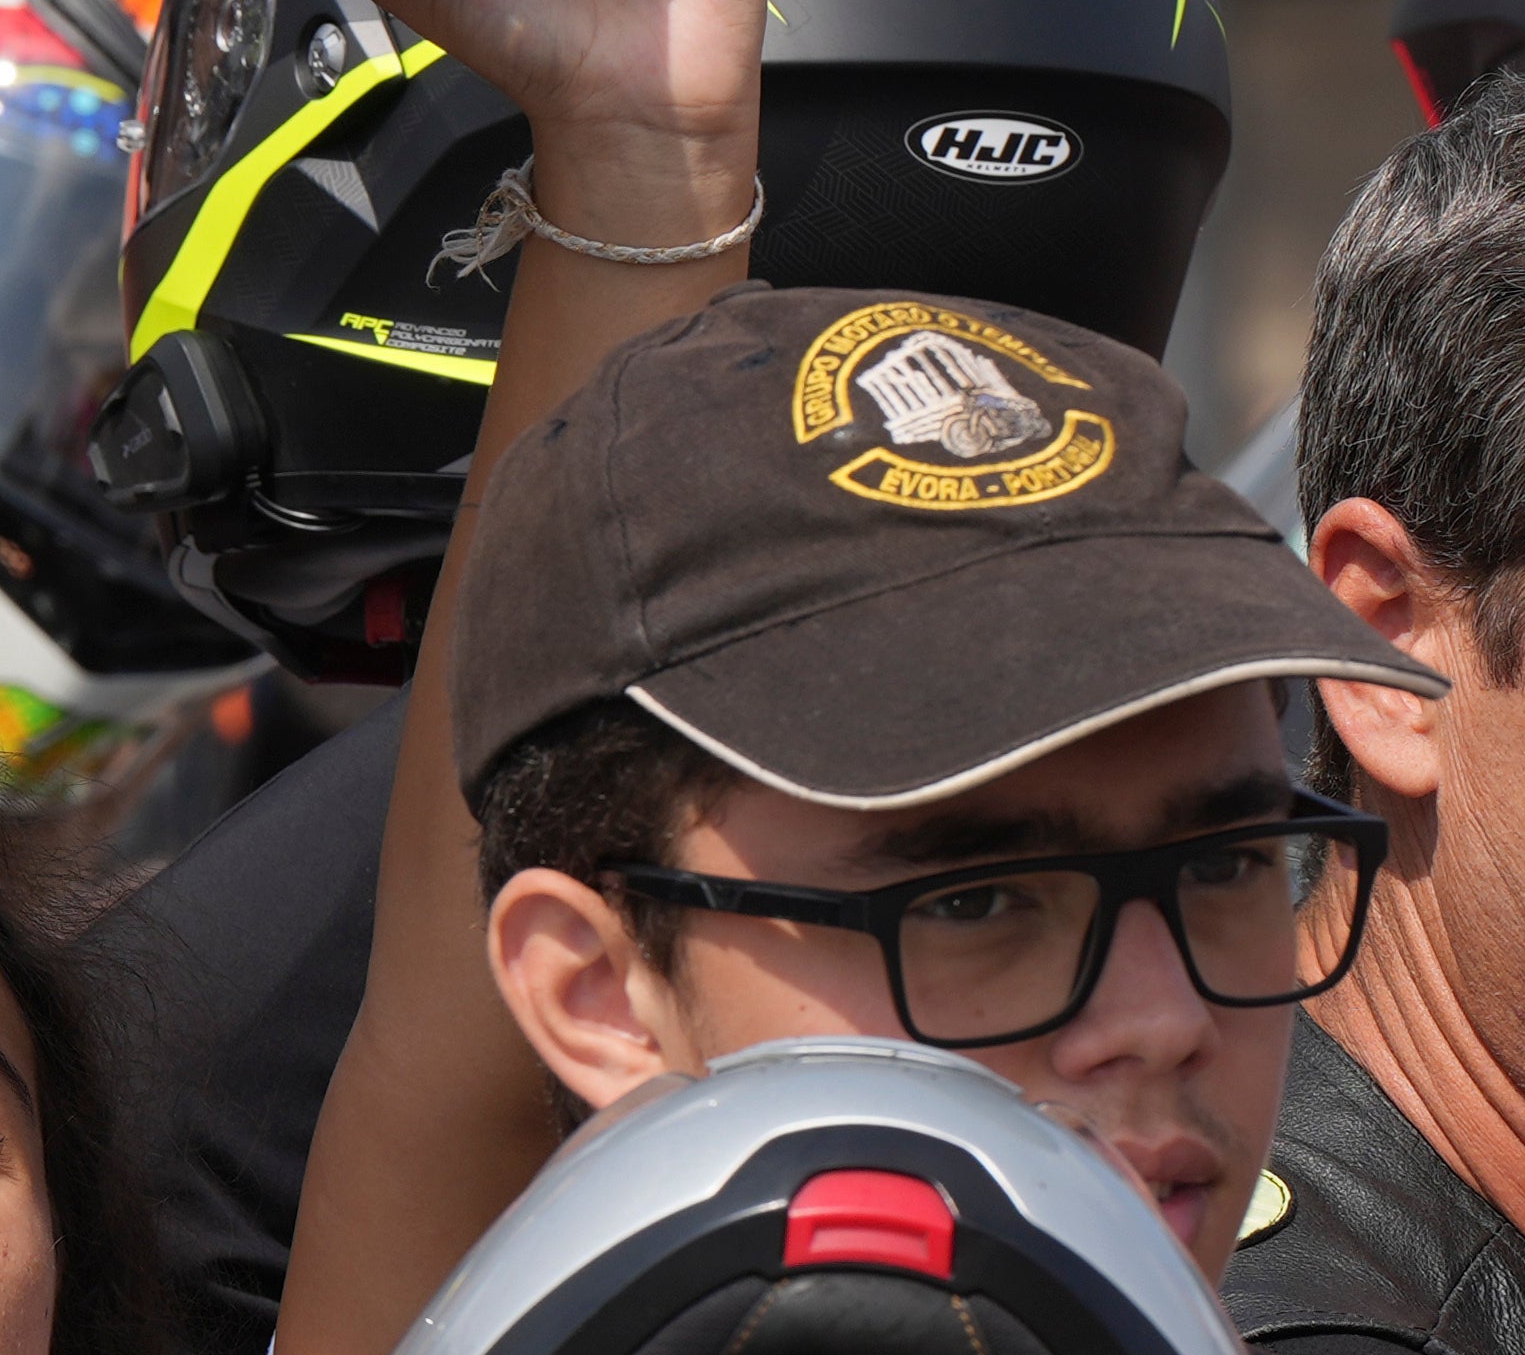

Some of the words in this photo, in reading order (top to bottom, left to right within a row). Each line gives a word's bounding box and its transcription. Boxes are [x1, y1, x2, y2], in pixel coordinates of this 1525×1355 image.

[930, 127, 1063, 166] HJC
[966, 162, 1027, 174] HELMETS
[339, 312, 394, 336] APC
[394, 322, 467, 338] ADVANCED
[385, 338, 467, 356] COMPOSITE
[805, 354, 841, 427] GRUPO
[824, 307, 932, 355] MOTARD
